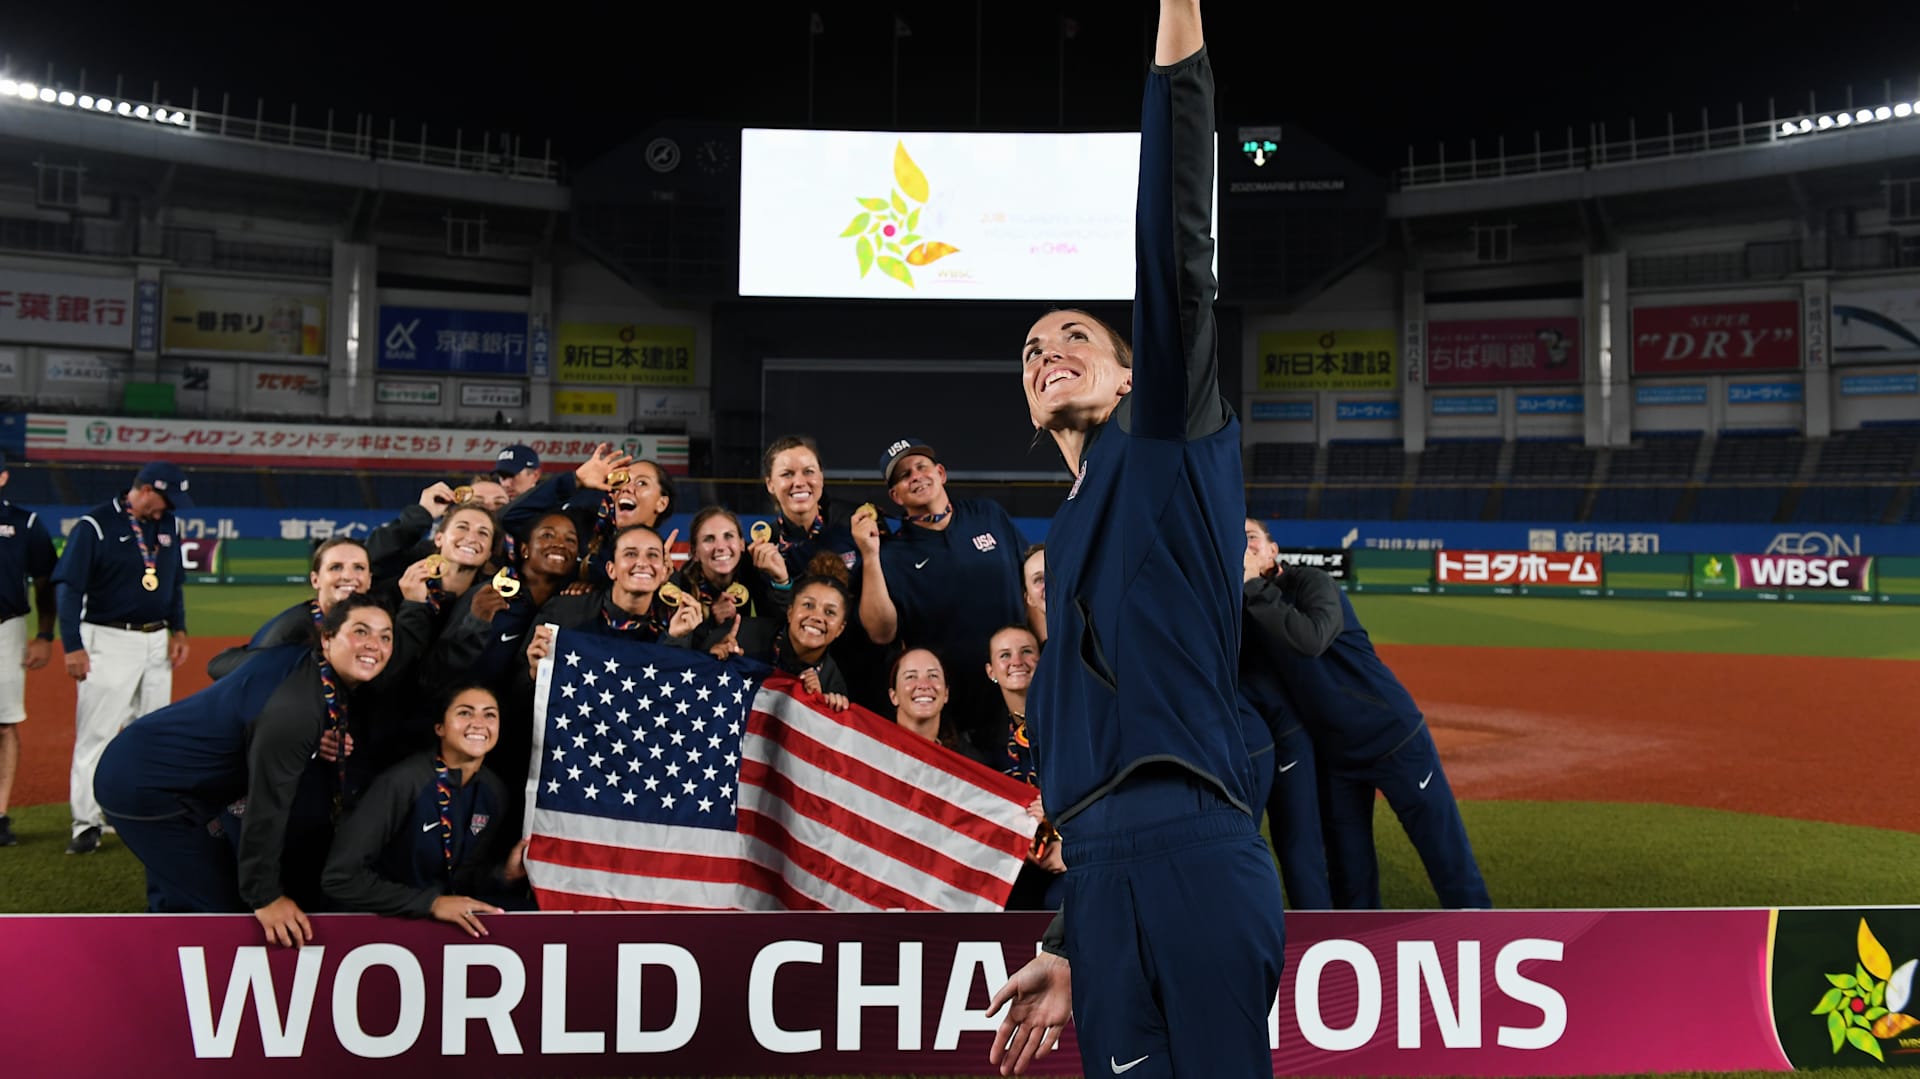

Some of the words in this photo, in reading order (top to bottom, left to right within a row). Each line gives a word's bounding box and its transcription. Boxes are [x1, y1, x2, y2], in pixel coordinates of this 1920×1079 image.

[1230, 181, 1297, 192] ZOZOMARINE
[1299, 180, 1344, 190] STADIUM
[172, 311, 265, 334] 一番搾り
[1689, 313, 1750, 328] SUPER
[436, 329, 525, 356] 京葉銀行
[563, 344, 690, 370] 新日本建設
[1264, 351, 1392, 376] 新日本建設
[1431, 342, 1536, 370] ちば興銀
[887, 439, 911, 457] USA
[972, 533, 997, 550] USA
[1365, 538, 1444, 550] 三井住友銀行
[1563, 531, 1660, 553] 新昭和
[1438, 552, 1599, 582] トヨタホーム
[1750, 558, 1849, 587] WBSC
[178, 942, 702, 1058] WORLD
[748, 938, 1568, 1058] CHAONS
